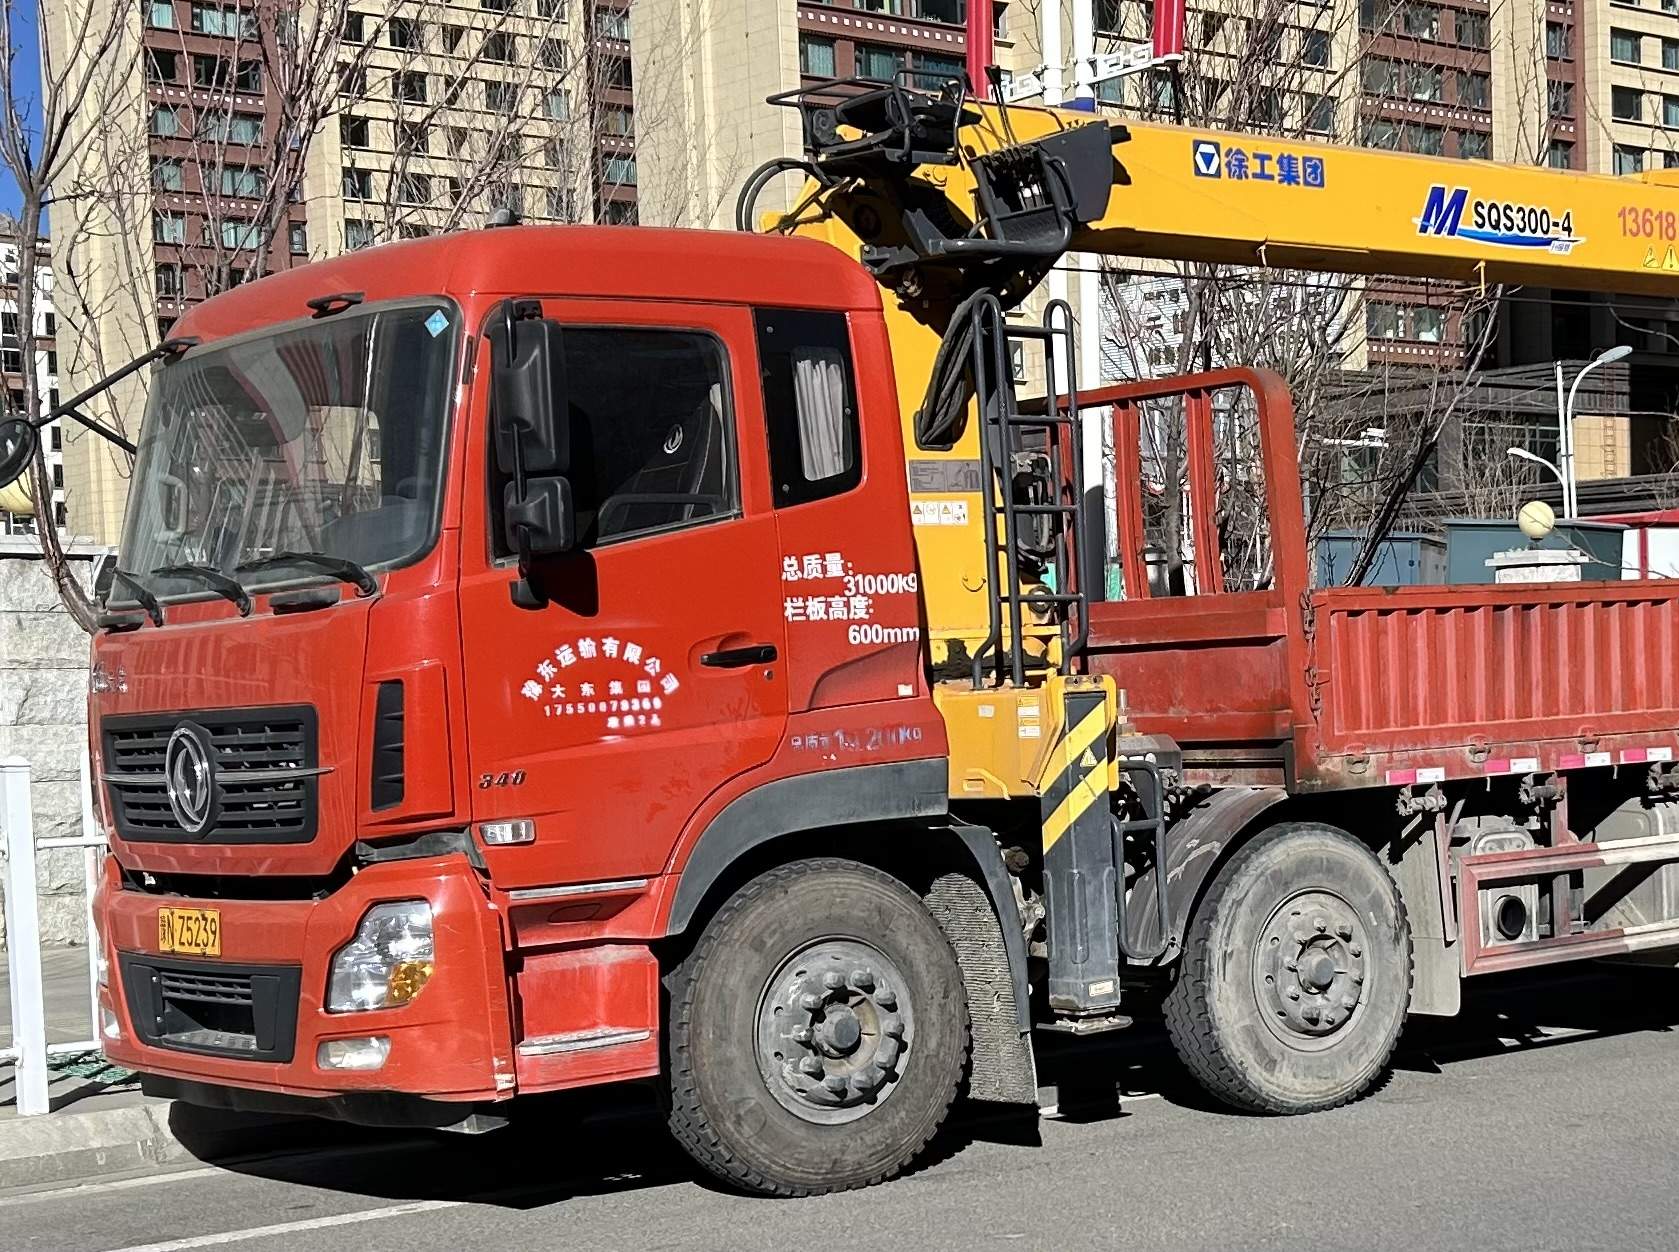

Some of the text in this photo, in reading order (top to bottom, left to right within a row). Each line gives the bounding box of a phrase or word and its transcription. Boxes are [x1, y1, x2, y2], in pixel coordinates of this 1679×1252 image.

[1225, 147, 1325, 188] 徐工集团
[1473, 200, 1573, 238] SQS300-4
[843, 572, 917, 596] 31000kg
[848, 624, 919, 644] 600mm
